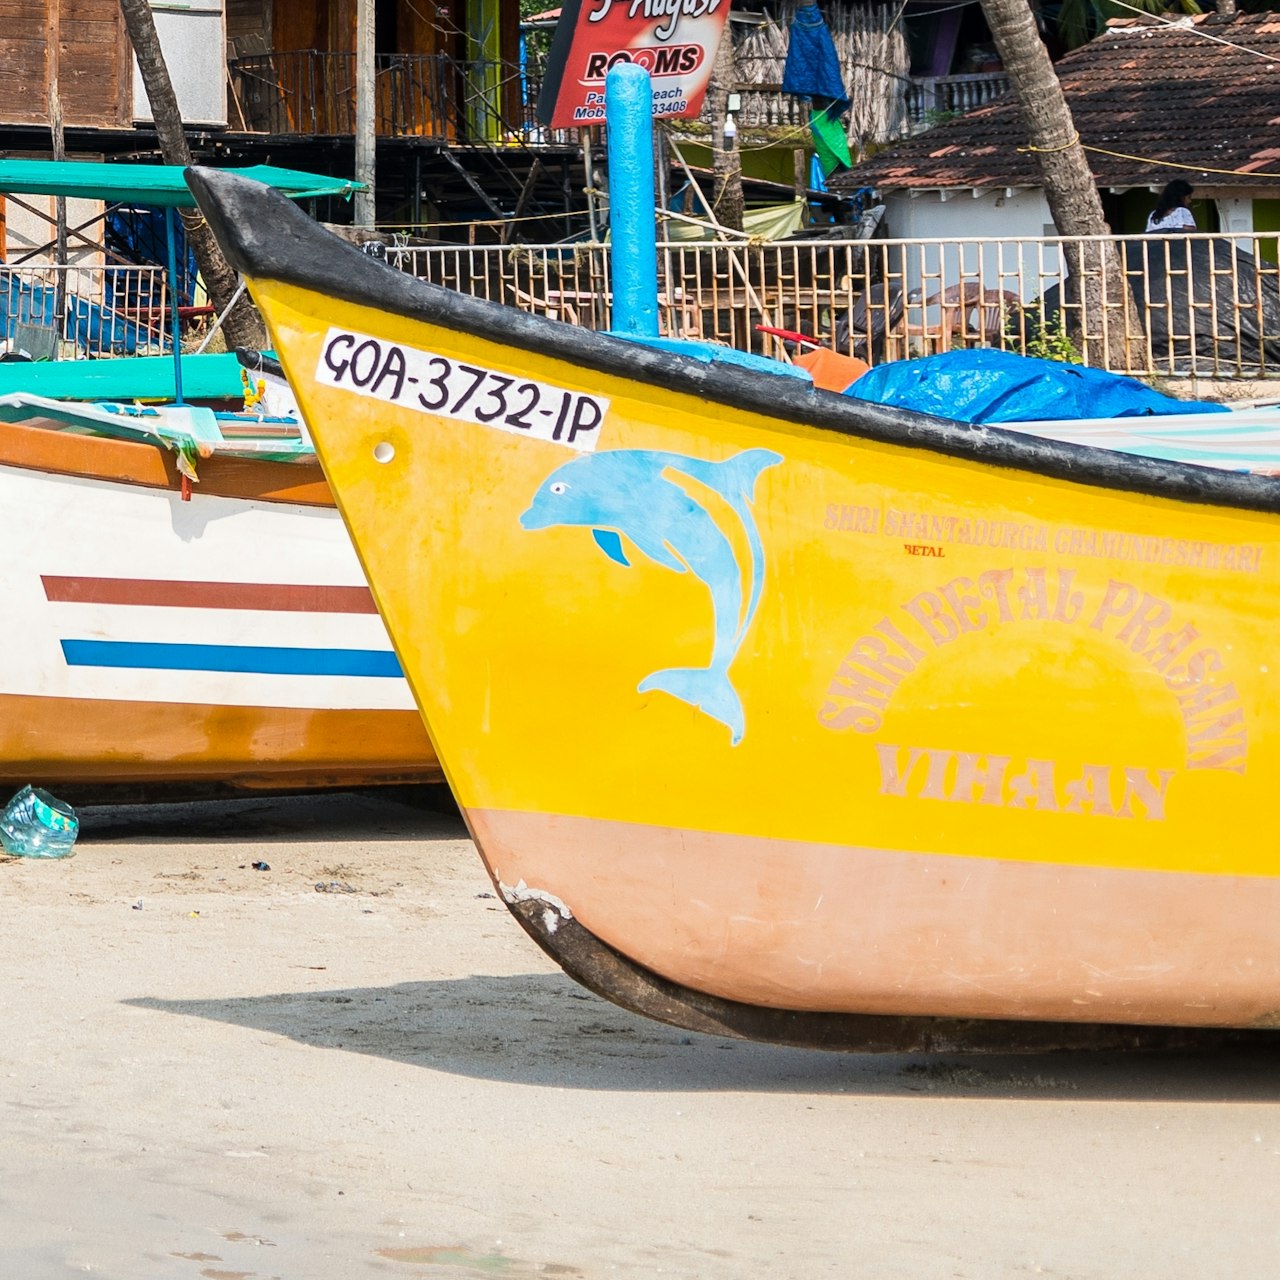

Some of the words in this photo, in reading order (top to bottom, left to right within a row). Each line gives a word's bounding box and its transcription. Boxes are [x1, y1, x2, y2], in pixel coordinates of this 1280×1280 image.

[651, 87, 683, 100] each
[324, 334, 602, 443] GOA-3732-IP
[824, 504, 881, 535] SHRI
[1054, 527, 1264, 574] CHAMUNDESHWARI
[817, 616, 927, 735] SHRI
[900, 567, 1084, 646] BETAL
[1089, 578, 1249, 775] PRASANN
[874, 742, 1176, 822] VIHAAN
